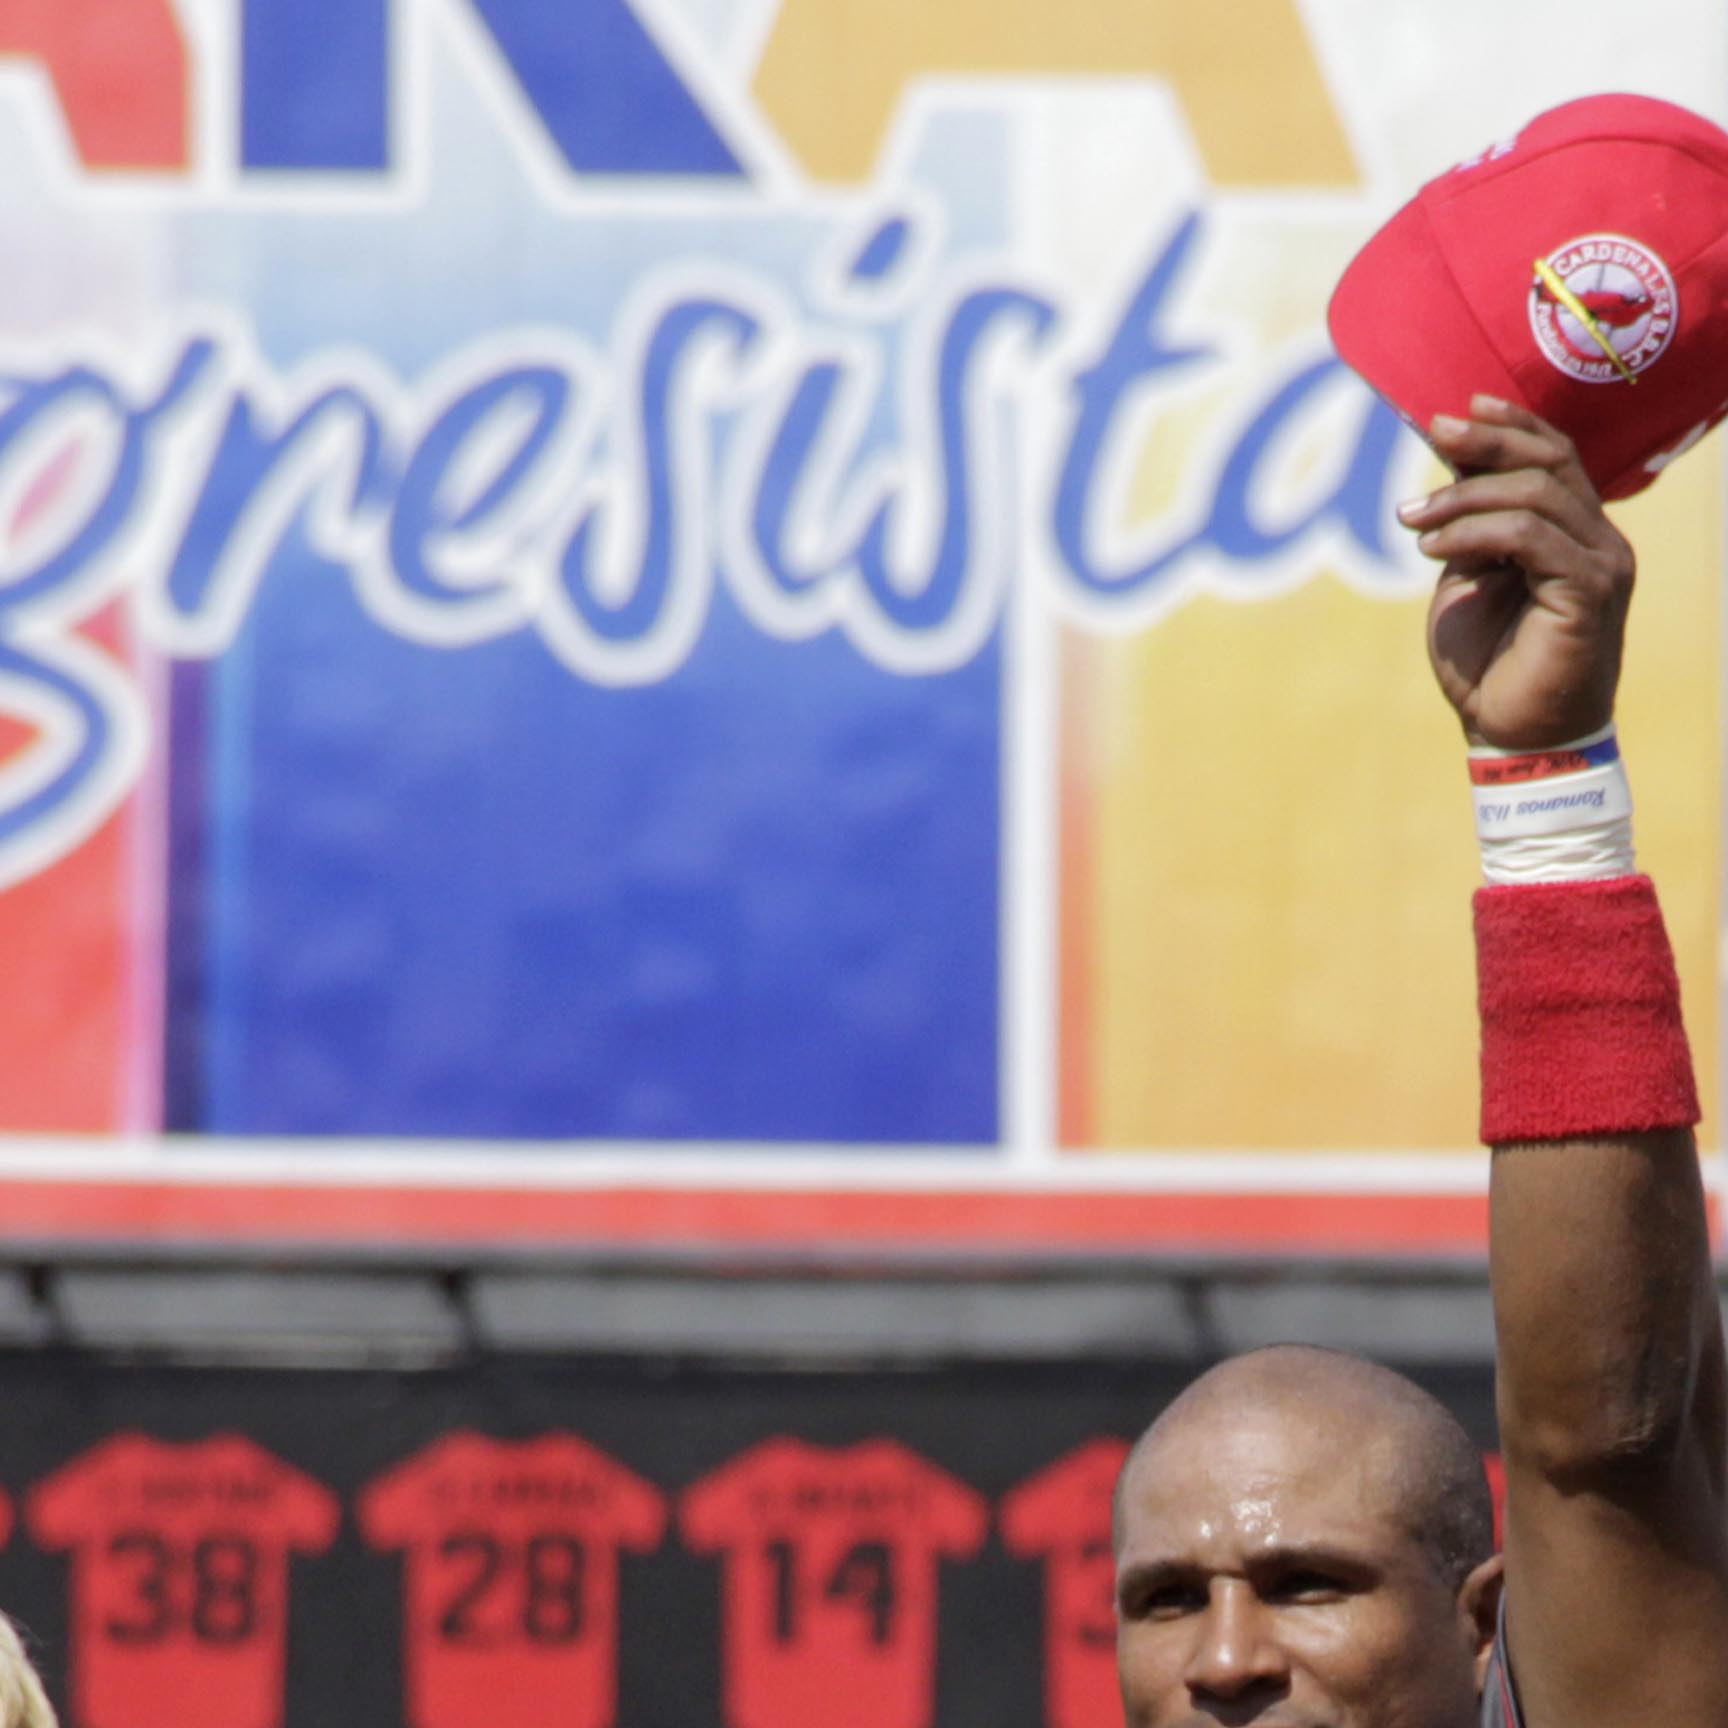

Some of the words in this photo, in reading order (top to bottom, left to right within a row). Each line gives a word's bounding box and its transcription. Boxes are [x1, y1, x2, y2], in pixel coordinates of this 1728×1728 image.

[1553, 241, 1671, 314] CARDENALES
[105, 1531, 257, 1645] 38
[436, 1531, 587, 1646] 28
[764, 1534, 896, 1647] 14
